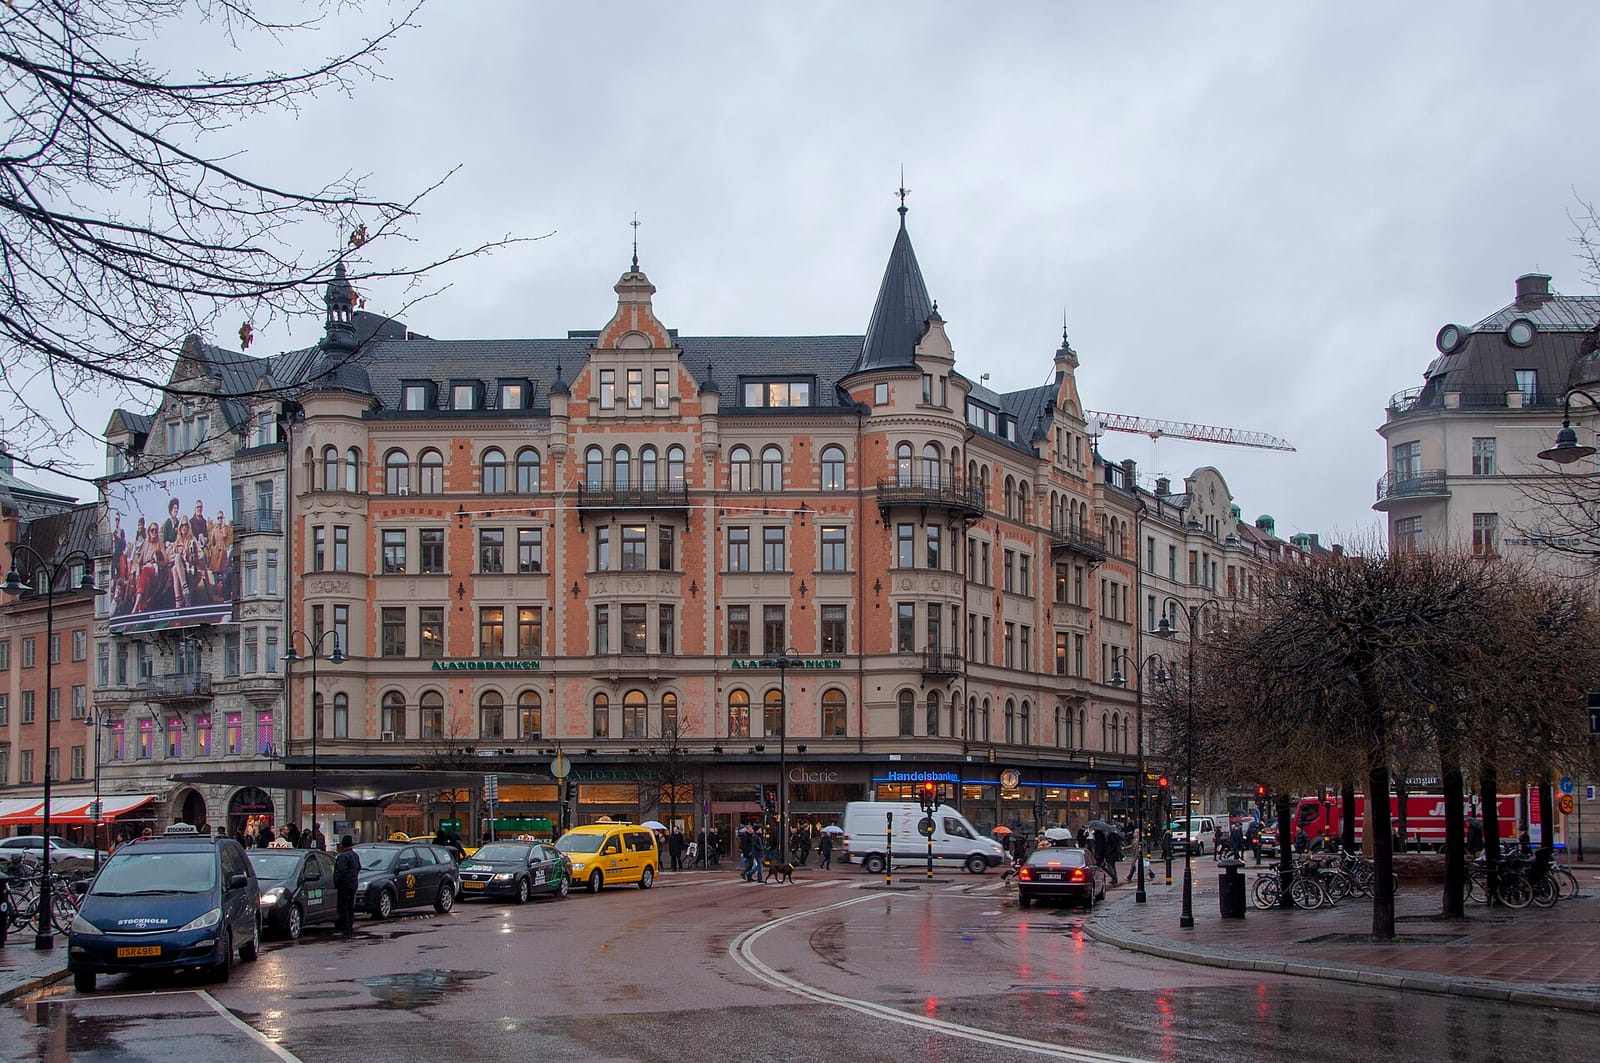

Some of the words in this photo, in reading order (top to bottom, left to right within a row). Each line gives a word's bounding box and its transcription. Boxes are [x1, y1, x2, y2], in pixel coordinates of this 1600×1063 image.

[169, 473, 208, 487] HILFIGER
[888, 770, 958, 782] Handelsbanken
[1563, 799, 1574, 809] 50
[118, 918, 168, 926] STOCKHOLM
